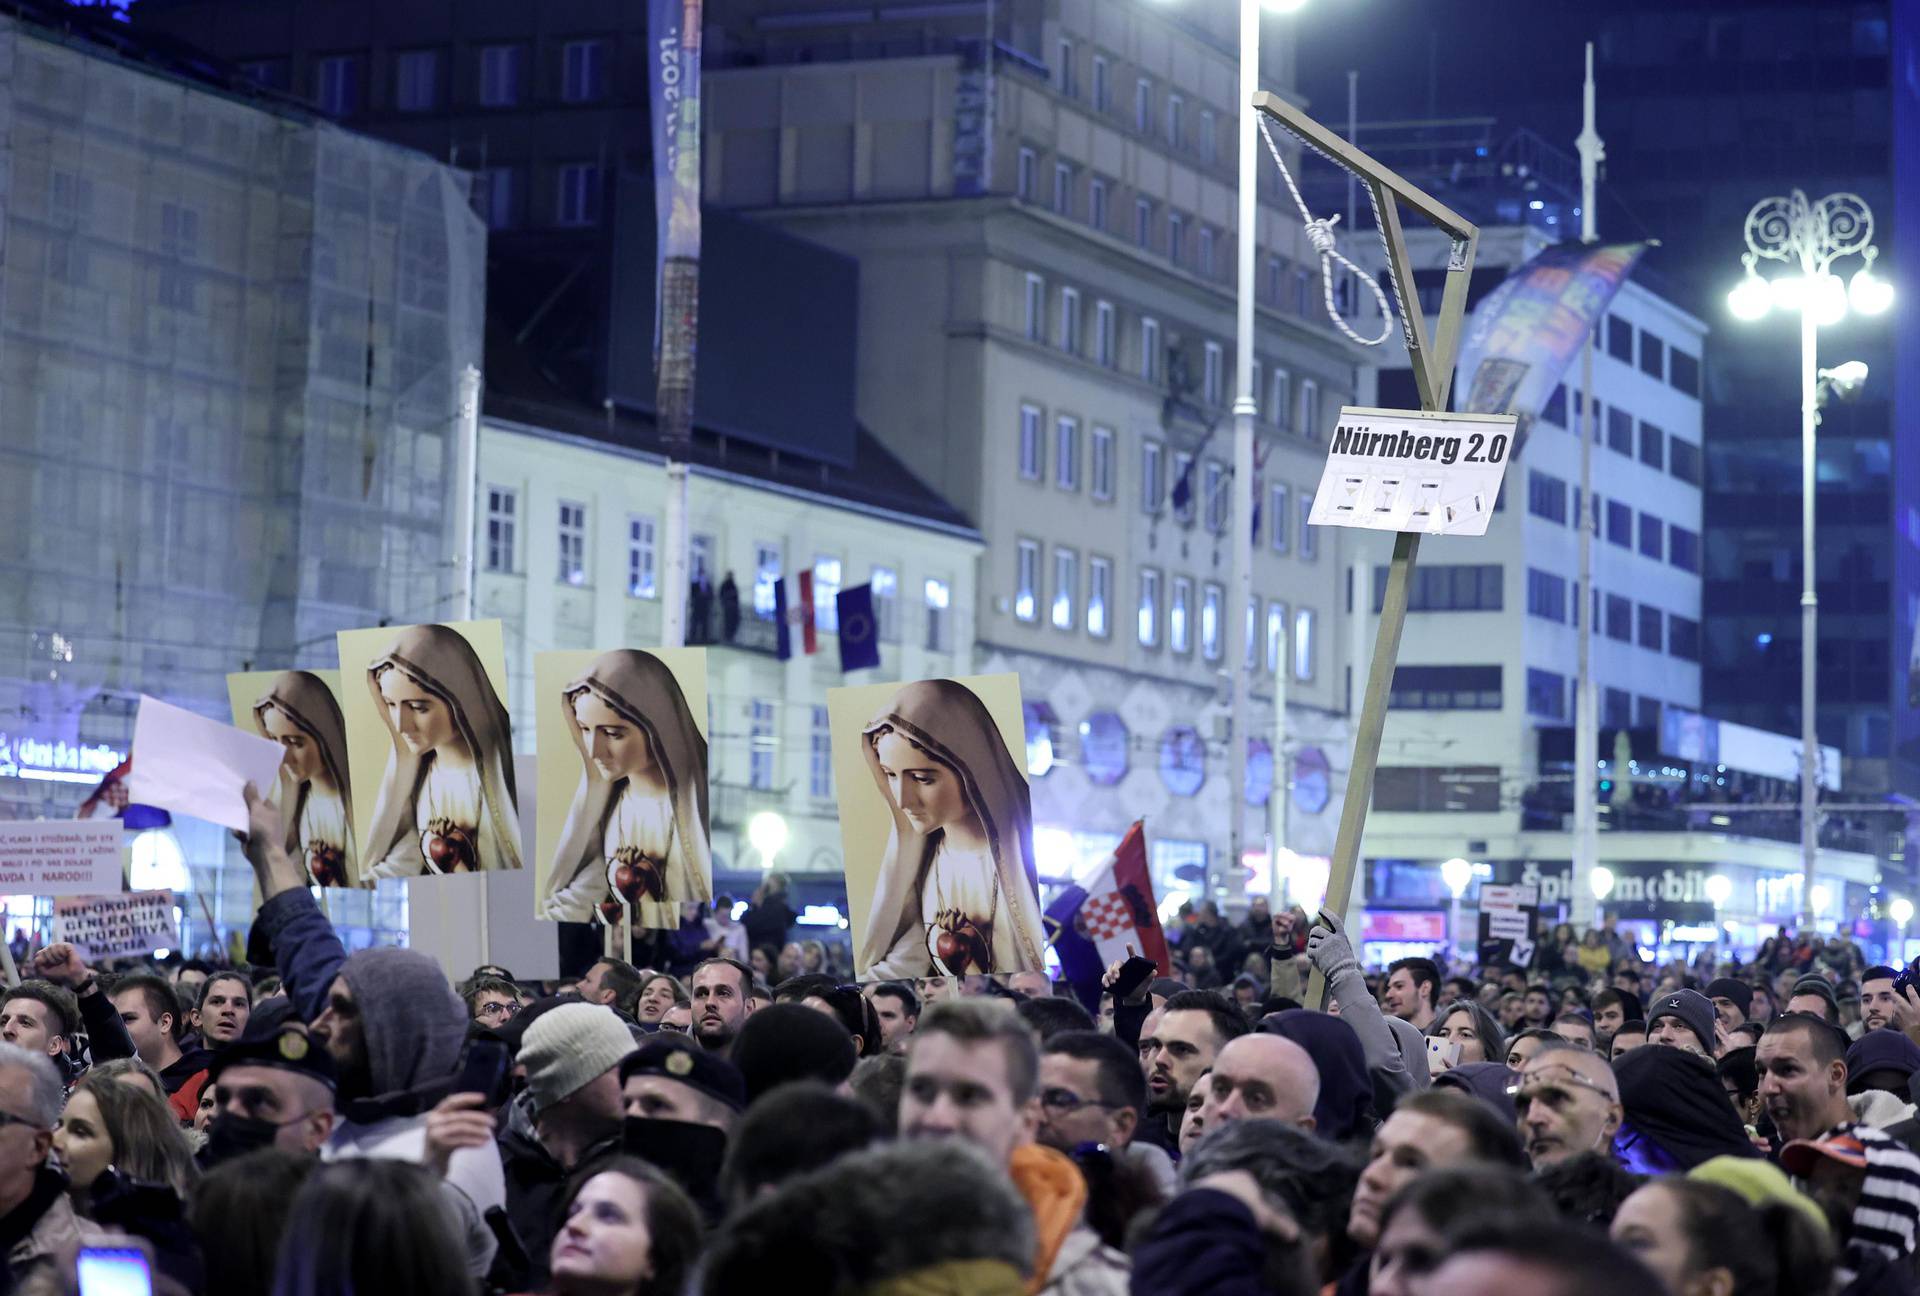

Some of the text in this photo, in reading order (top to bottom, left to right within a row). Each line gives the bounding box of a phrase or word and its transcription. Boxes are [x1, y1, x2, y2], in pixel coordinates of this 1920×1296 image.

[1331, 426, 1508, 465] Nürnberg 2.0
[42, 871, 93, 883] NAROD!!!
[61, 895, 167, 917] NEPOKORIVA
[65, 908, 165, 931] GENERACIJA
[64, 922, 169, 944] NEPOKORIVA
[89, 938, 147, 956] NACIJA
